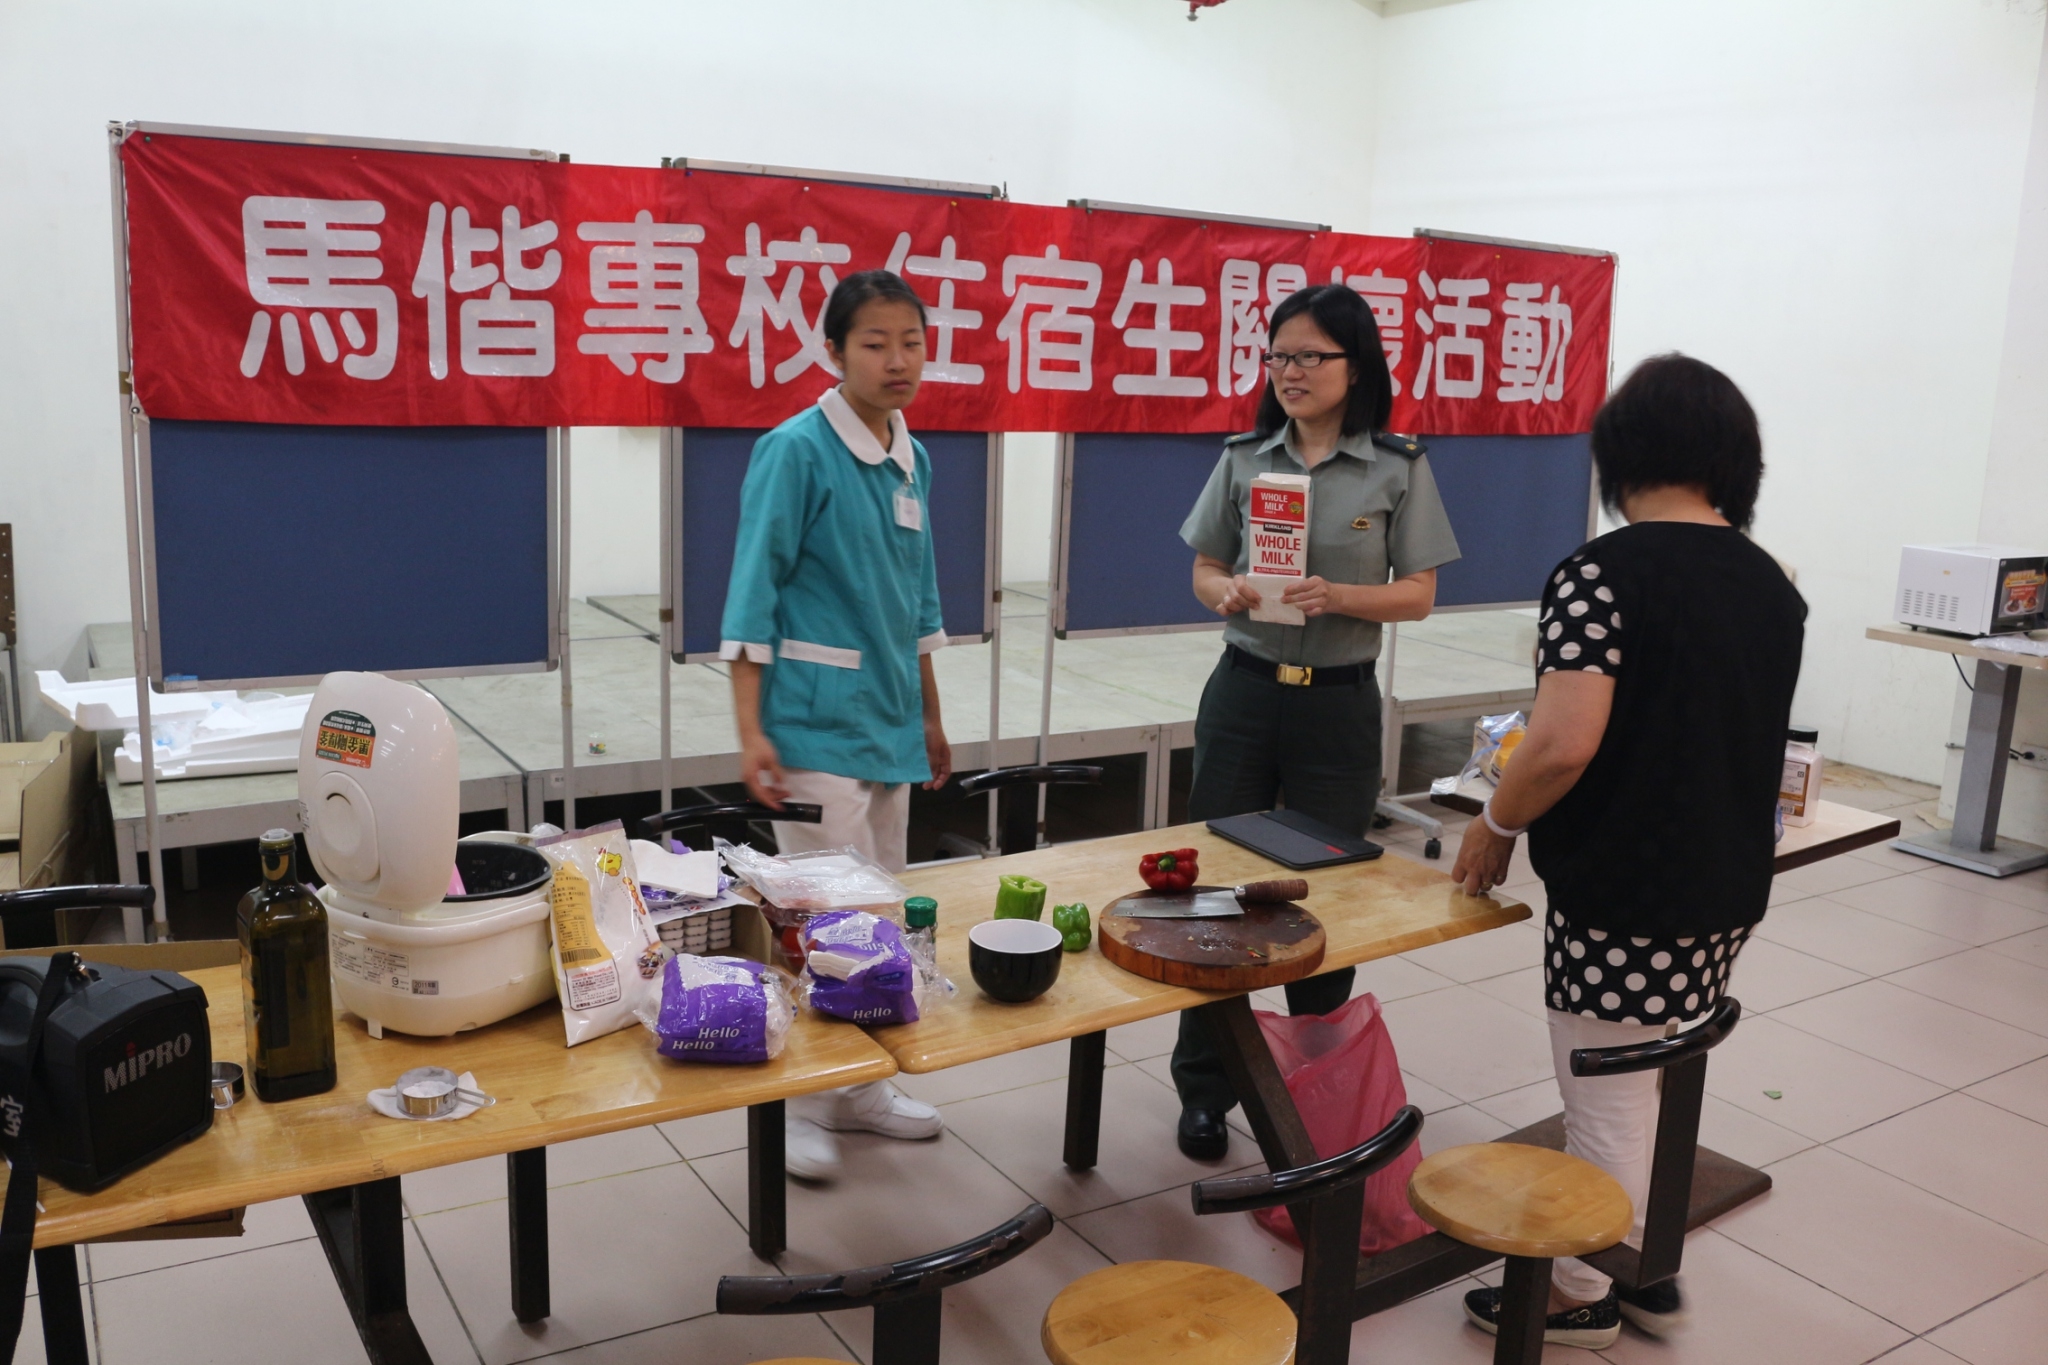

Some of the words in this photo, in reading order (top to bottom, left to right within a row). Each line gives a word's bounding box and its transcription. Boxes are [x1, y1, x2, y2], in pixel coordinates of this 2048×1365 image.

[1261, 493, 1288, 502] WHOLE
[1264, 502, 1284, 511] MILK
[1255, 534, 1301, 551] WHOLE
[1261, 550, 1294, 566] MILK
[853, 1007, 892, 1020] Hello
[698, 1026, 740, 1039] Hello
[672, 1040, 715, 1050] Hello
